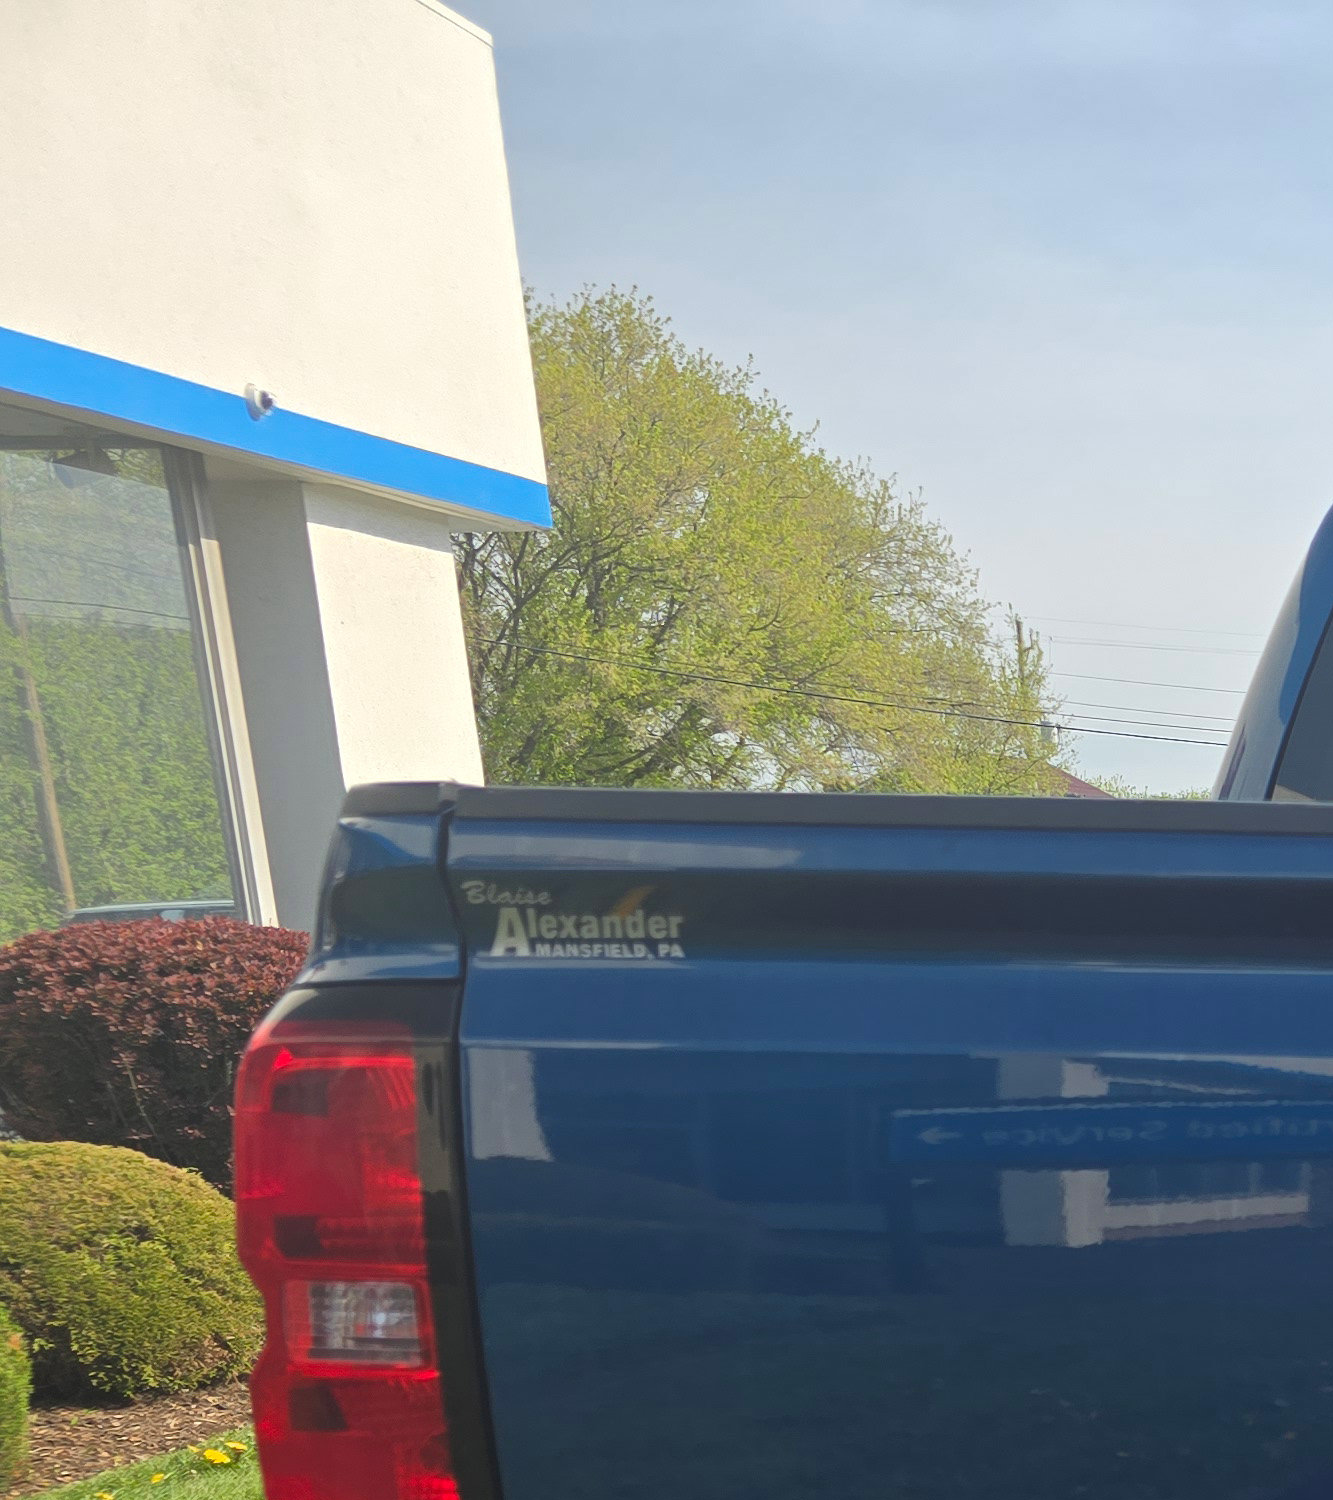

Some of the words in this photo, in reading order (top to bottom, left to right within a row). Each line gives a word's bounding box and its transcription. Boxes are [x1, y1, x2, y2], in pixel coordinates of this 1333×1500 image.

[461, 880, 550, 904] Blaise
[490, 907, 685, 957] Alexander
[658, 943, 686, 958] PA
